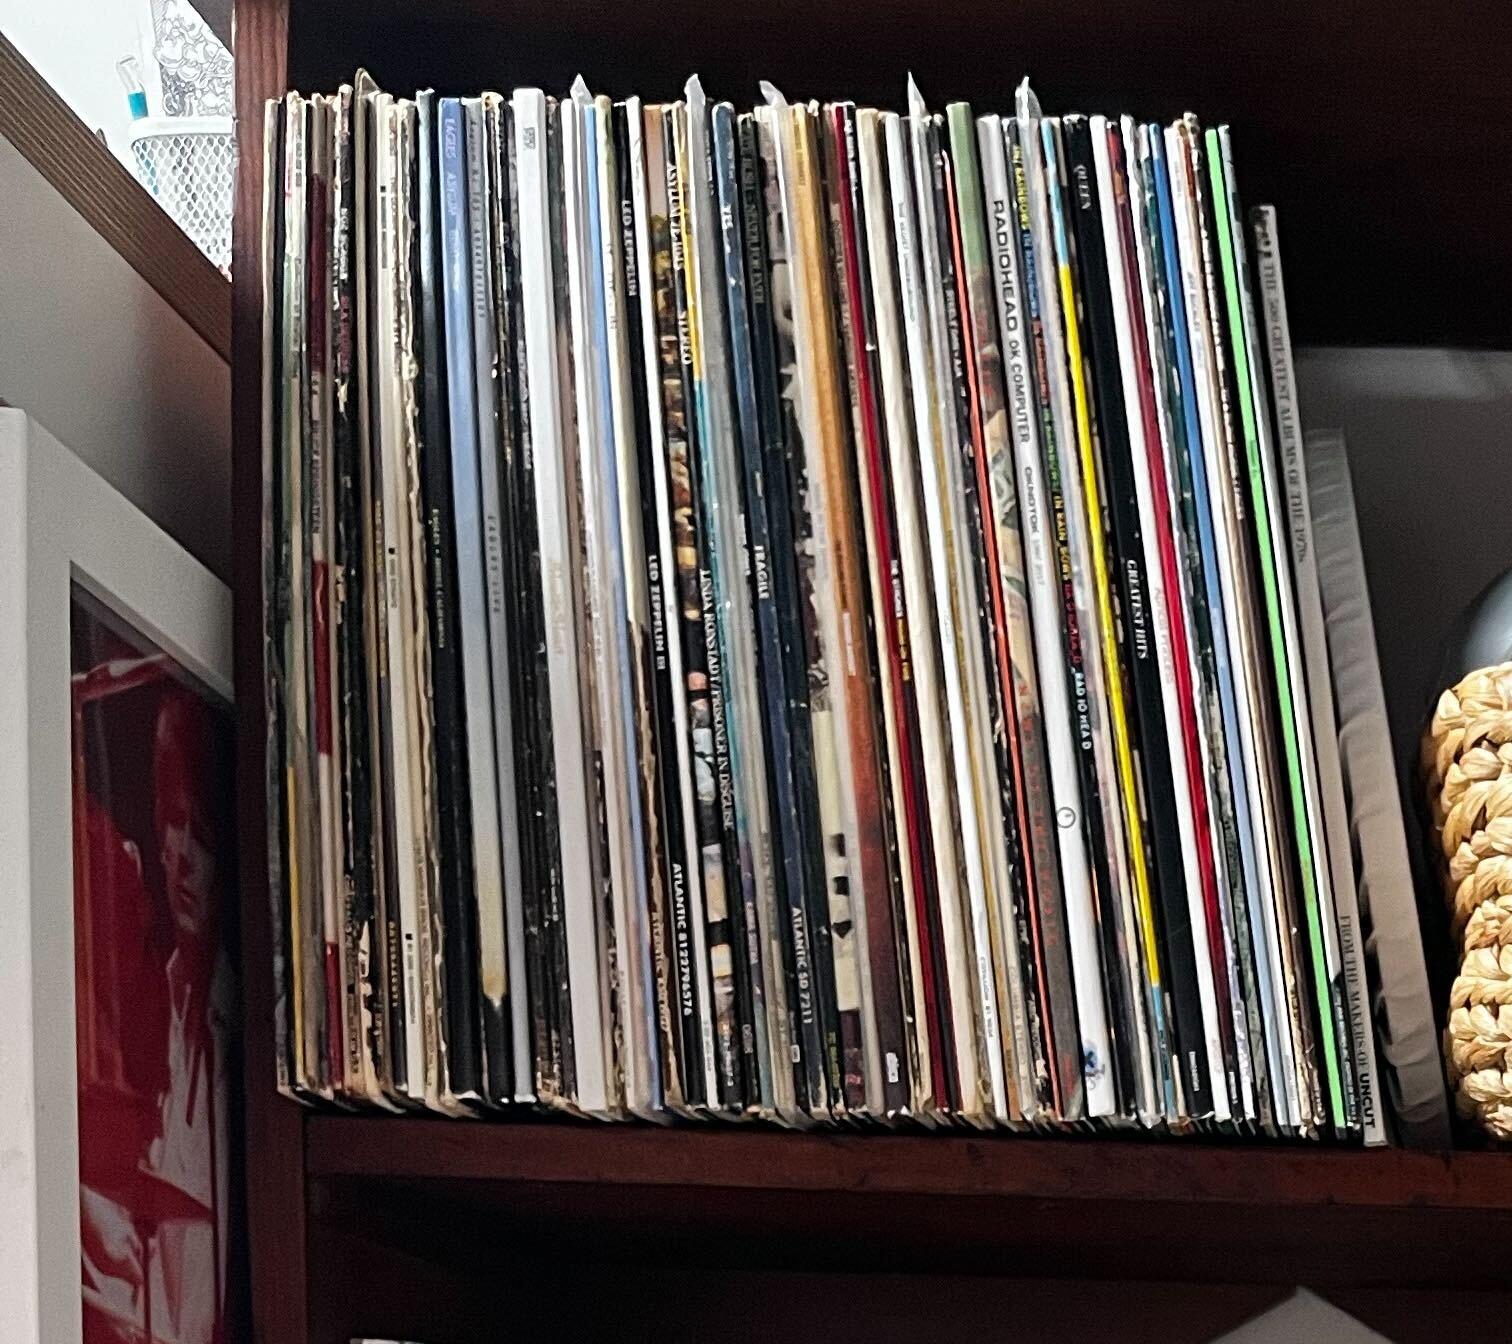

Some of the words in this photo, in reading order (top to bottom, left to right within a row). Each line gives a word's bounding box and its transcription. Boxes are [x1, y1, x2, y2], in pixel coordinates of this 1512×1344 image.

[1073, 164, 1092, 211] QUEEN
[624, 229, 639, 297] ZEPPELIN
[993, 199, 1019, 332] RADIOHEAD
[1263, 262, 1277, 292] THE
[1267, 297, 1280, 323] 500
[1010, 339, 1021, 360] OK
[1270, 325, 1291, 404] GREATEST
[1011, 364, 1031, 444] COMPUTER
[1280, 406, 1299, 467] ALBUMS
[1288, 469, 1301, 485] OF
[1290, 491, 1305, 524] THE
[648, 555, 660, 581] LED
[754, 545, 770, 600] FRAGILE
[1125, 559, 1144, 626] GREATEST
[651, 585, 665, 652] ZEPPELIN
[1134, 628, 1148, 660] HITS
[698, 568, 716, 609] LINDA
[718, 773, 736, 832] DISGUISE
[672, 863, 689, 930] ATLANTIC
[792, 907, 809, 968] ATLANTIC
[1339, 915, 1354, 957] FROM
[1343, 959, 1358, 984] THE
[799, 992, 813, 1024] 7211
[1347, 989, 1365, 1046] MAKERS
[1355, 1053, 1368, 1070] OF
[1358, 1073, 1377, 1129] UNCUT
